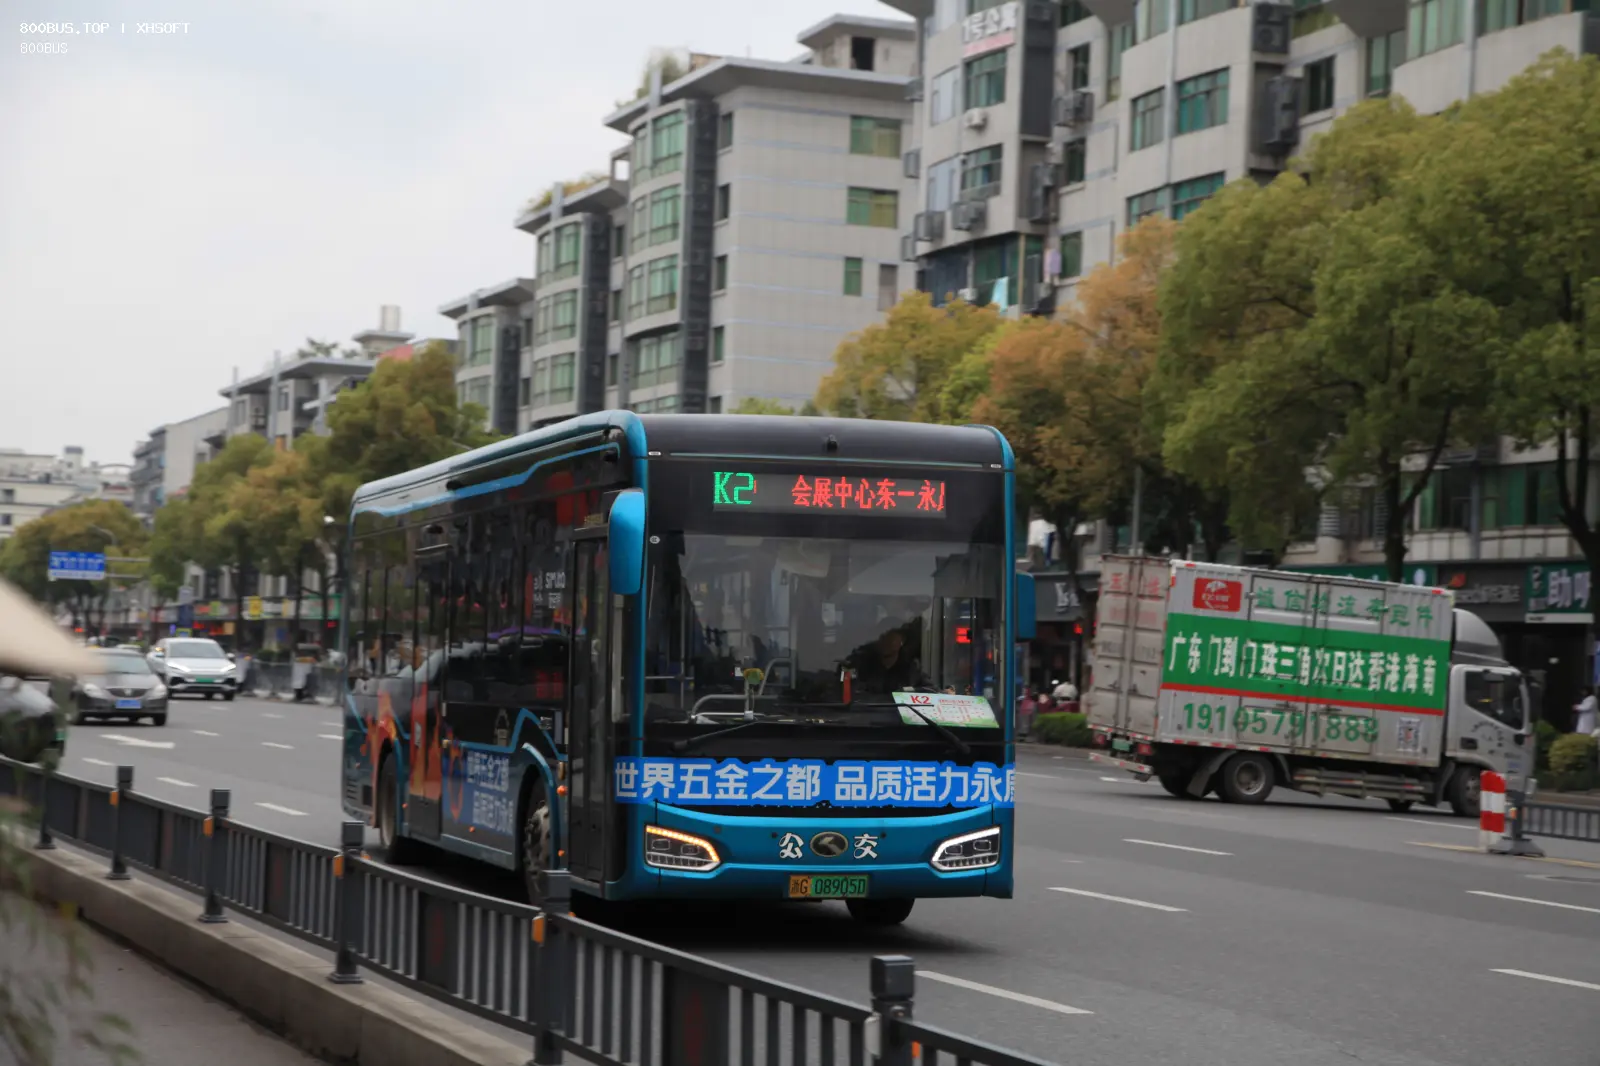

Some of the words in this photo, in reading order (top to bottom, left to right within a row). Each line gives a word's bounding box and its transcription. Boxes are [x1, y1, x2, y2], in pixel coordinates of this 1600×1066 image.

[713, 471, 755, 505] K2
[910, 695, 931, 705] K2
[615, 762, 821, 801] 世界五金之都
